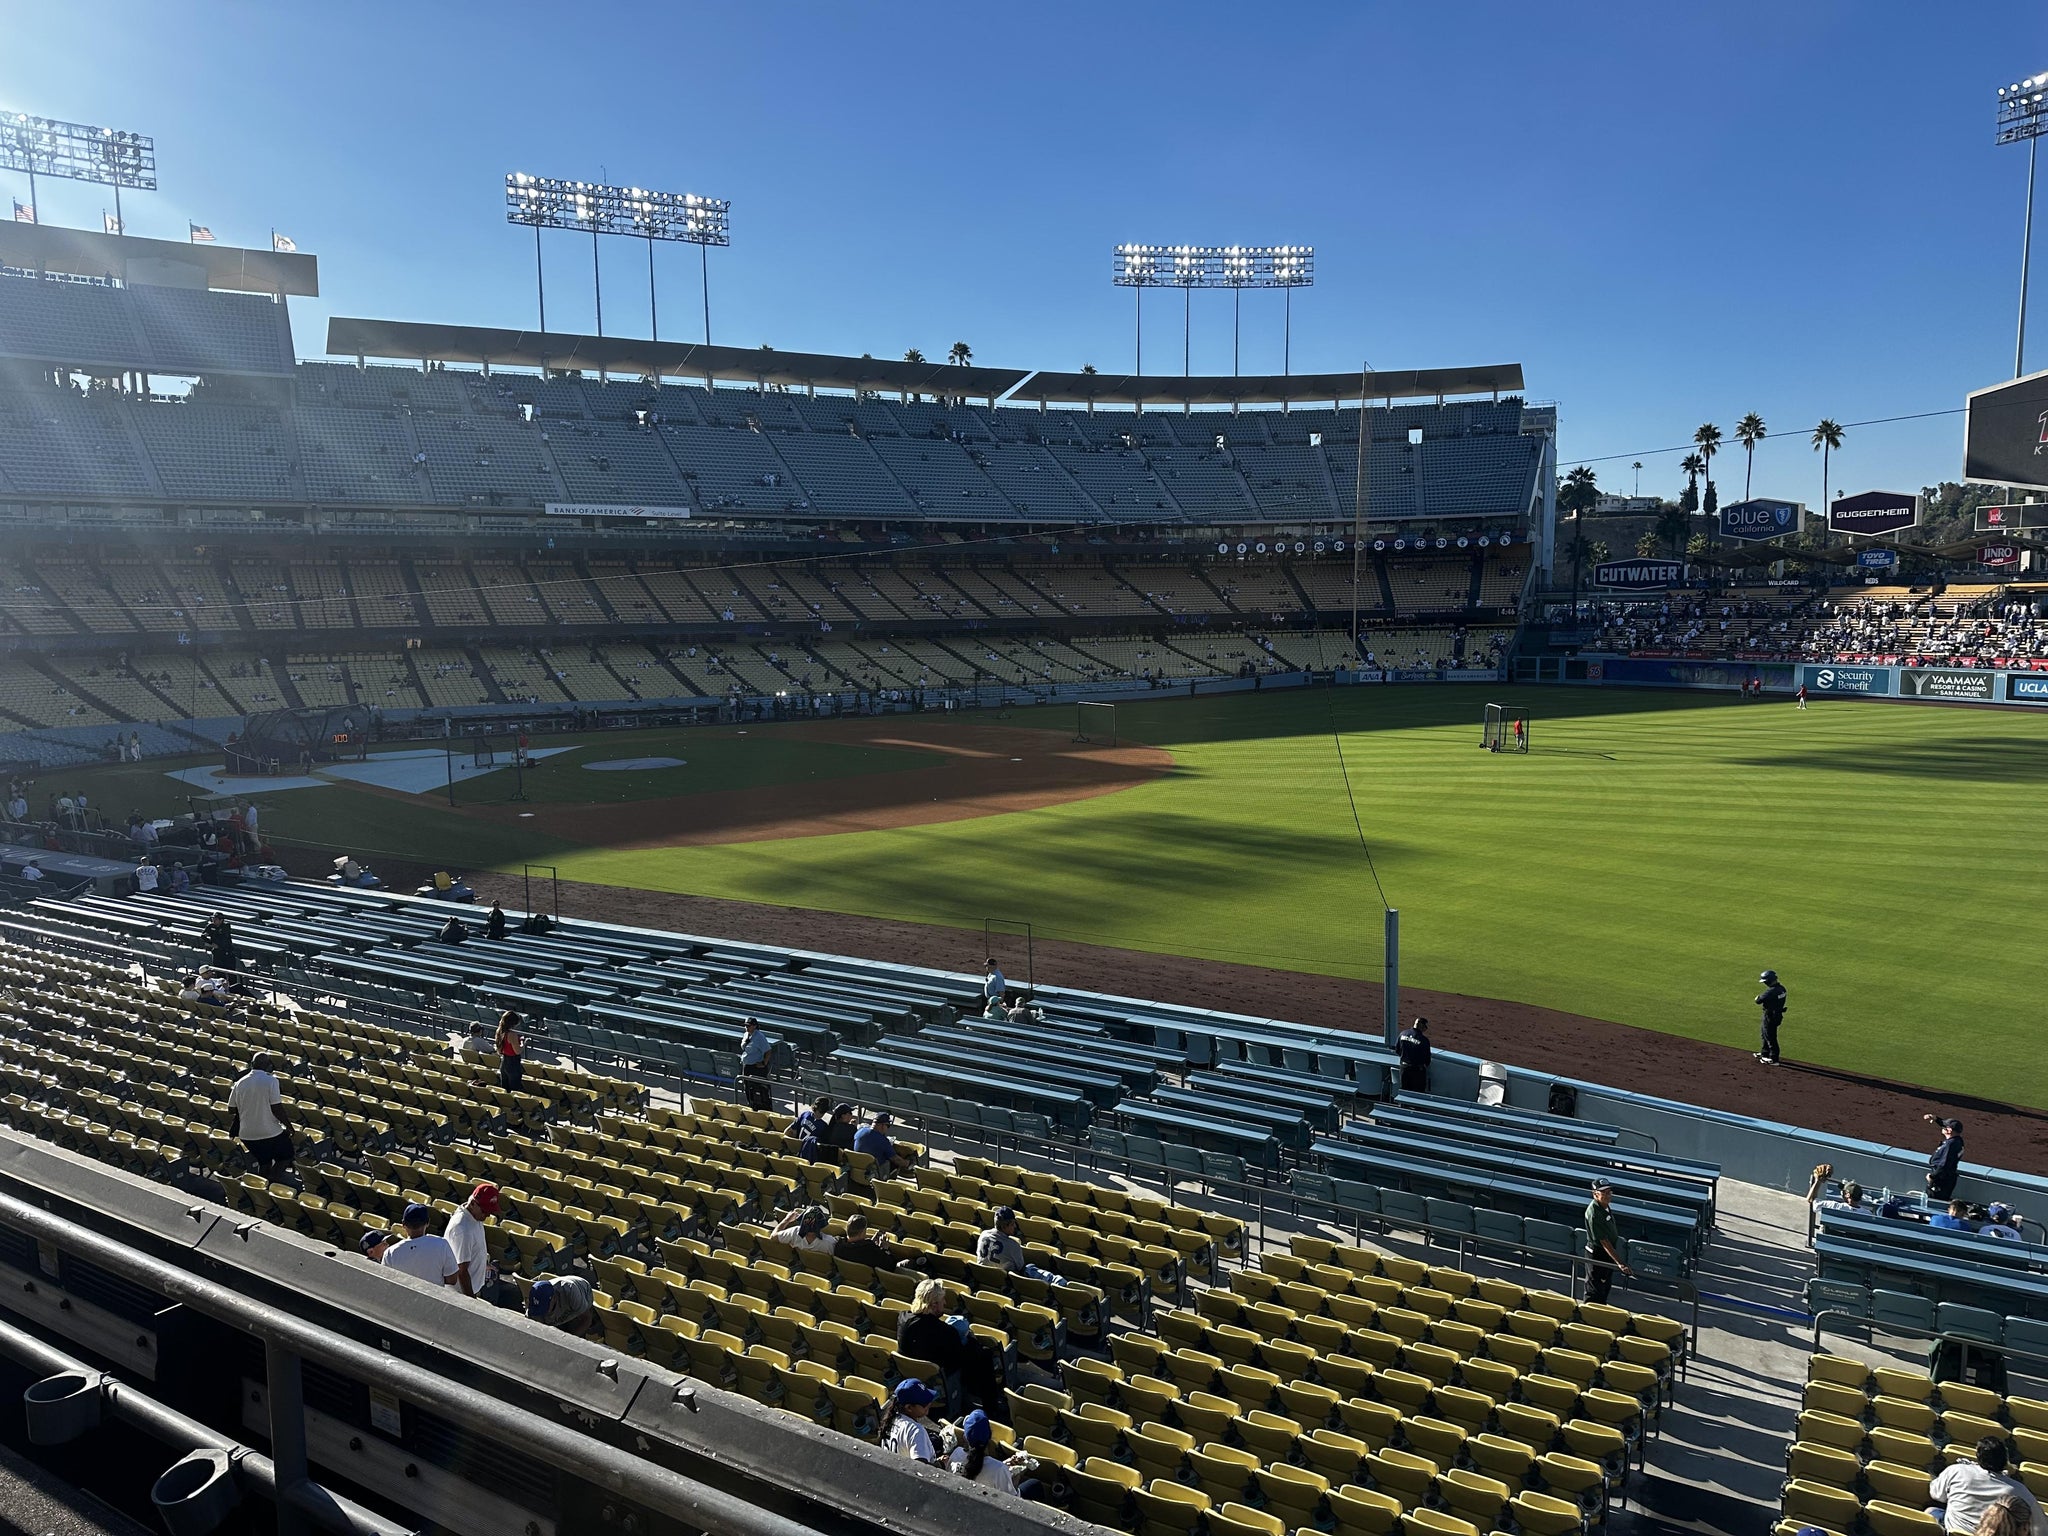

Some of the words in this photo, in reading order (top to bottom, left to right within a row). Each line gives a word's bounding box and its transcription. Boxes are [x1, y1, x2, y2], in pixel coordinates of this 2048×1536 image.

[1728, 508, 1770, 525] blue
[1836, 508, 1909, 518] GUGGENHEIM
[1733, 525, 1775, 533] california
[1983, 548, 2013, 560] JINRO
[1600, 566, 1677, 581] CUTWATER
[1362, 673, 1380, 681] ANA
[1838, 671, 1874, 682] Security
[1838, 681, 1869, 691] Benefit
[2019, 682, 2048, 693] UCLA
